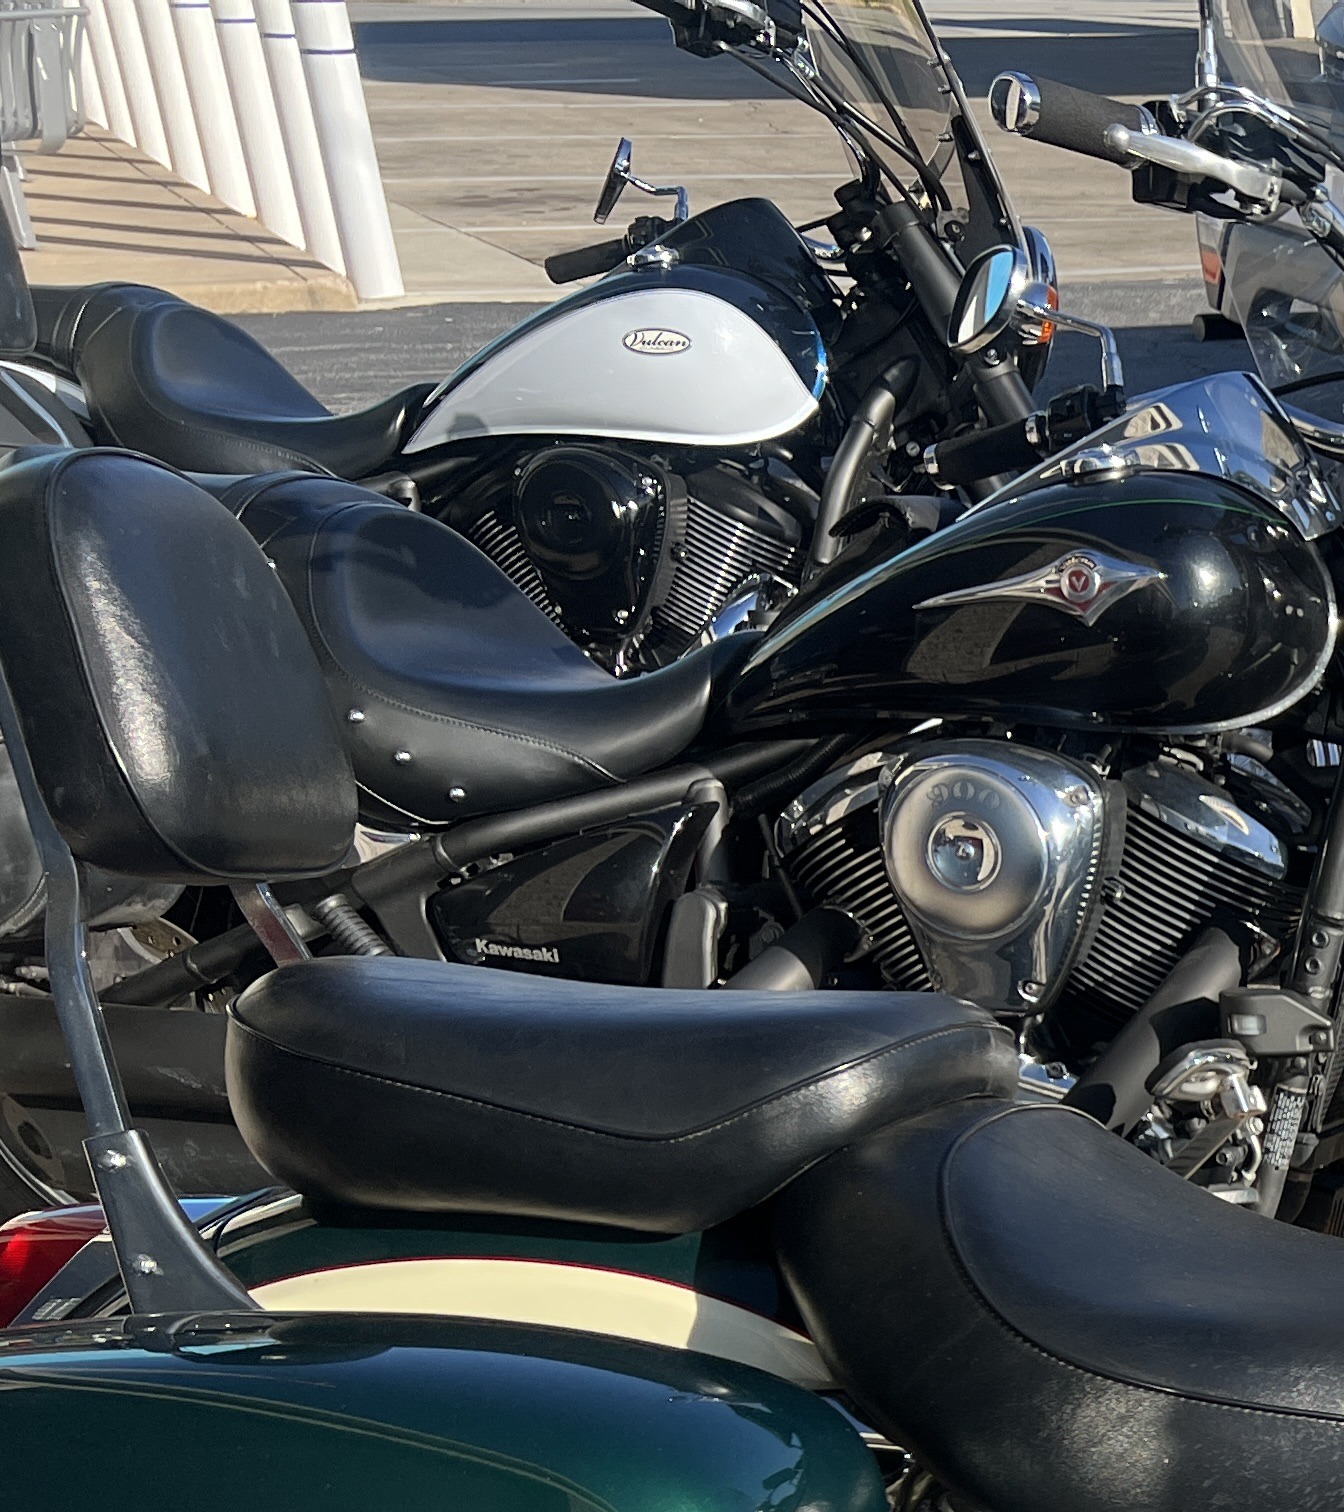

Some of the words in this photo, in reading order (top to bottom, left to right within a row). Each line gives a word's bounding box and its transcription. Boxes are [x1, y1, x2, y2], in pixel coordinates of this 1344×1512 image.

[630, 331, 686, 347] Vulcan
[926, 781, 1001, 810] 900
[474, 937, 560, 963] Kawasaki
